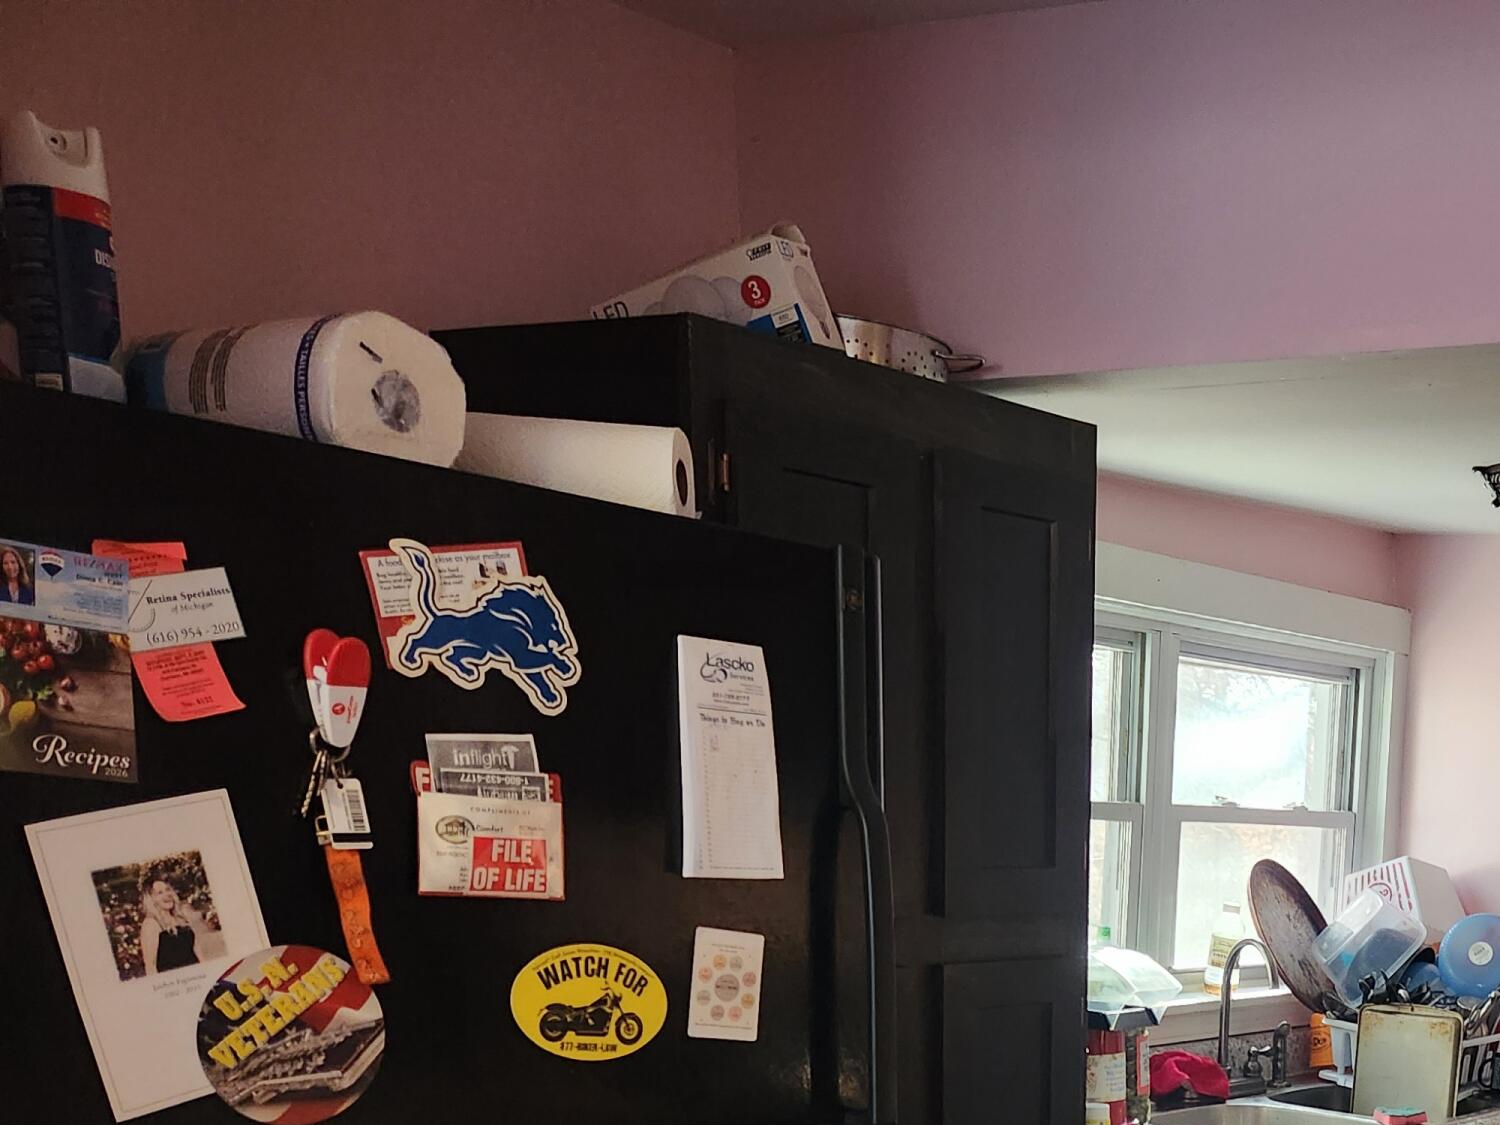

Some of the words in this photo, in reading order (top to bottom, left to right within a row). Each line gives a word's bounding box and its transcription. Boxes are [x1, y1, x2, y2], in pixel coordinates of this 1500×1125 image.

[747, 280, 762, 300] 3
[145, 594, 178, 606] Retina
[179, 586, 231, 602] Specialists
[145, 629, 180, 646] (616)
[180, 626, 203, 639] 954
[211, 620, 241, 636] 2020
[706, 652, 754, 672] Lascko
[32, 734, 131, 775] Recipes
[103, 767, 129, 778] 2026
[491, 839, 534, 865] FILE
[472, 866, 500, 890] OF
[504, 867, 546, 892] LIFE
[536, 955, 610, 991] WATCH
[613, 962, 649, 997] FOR
[207, 955, 346, 1069] VETERANS
